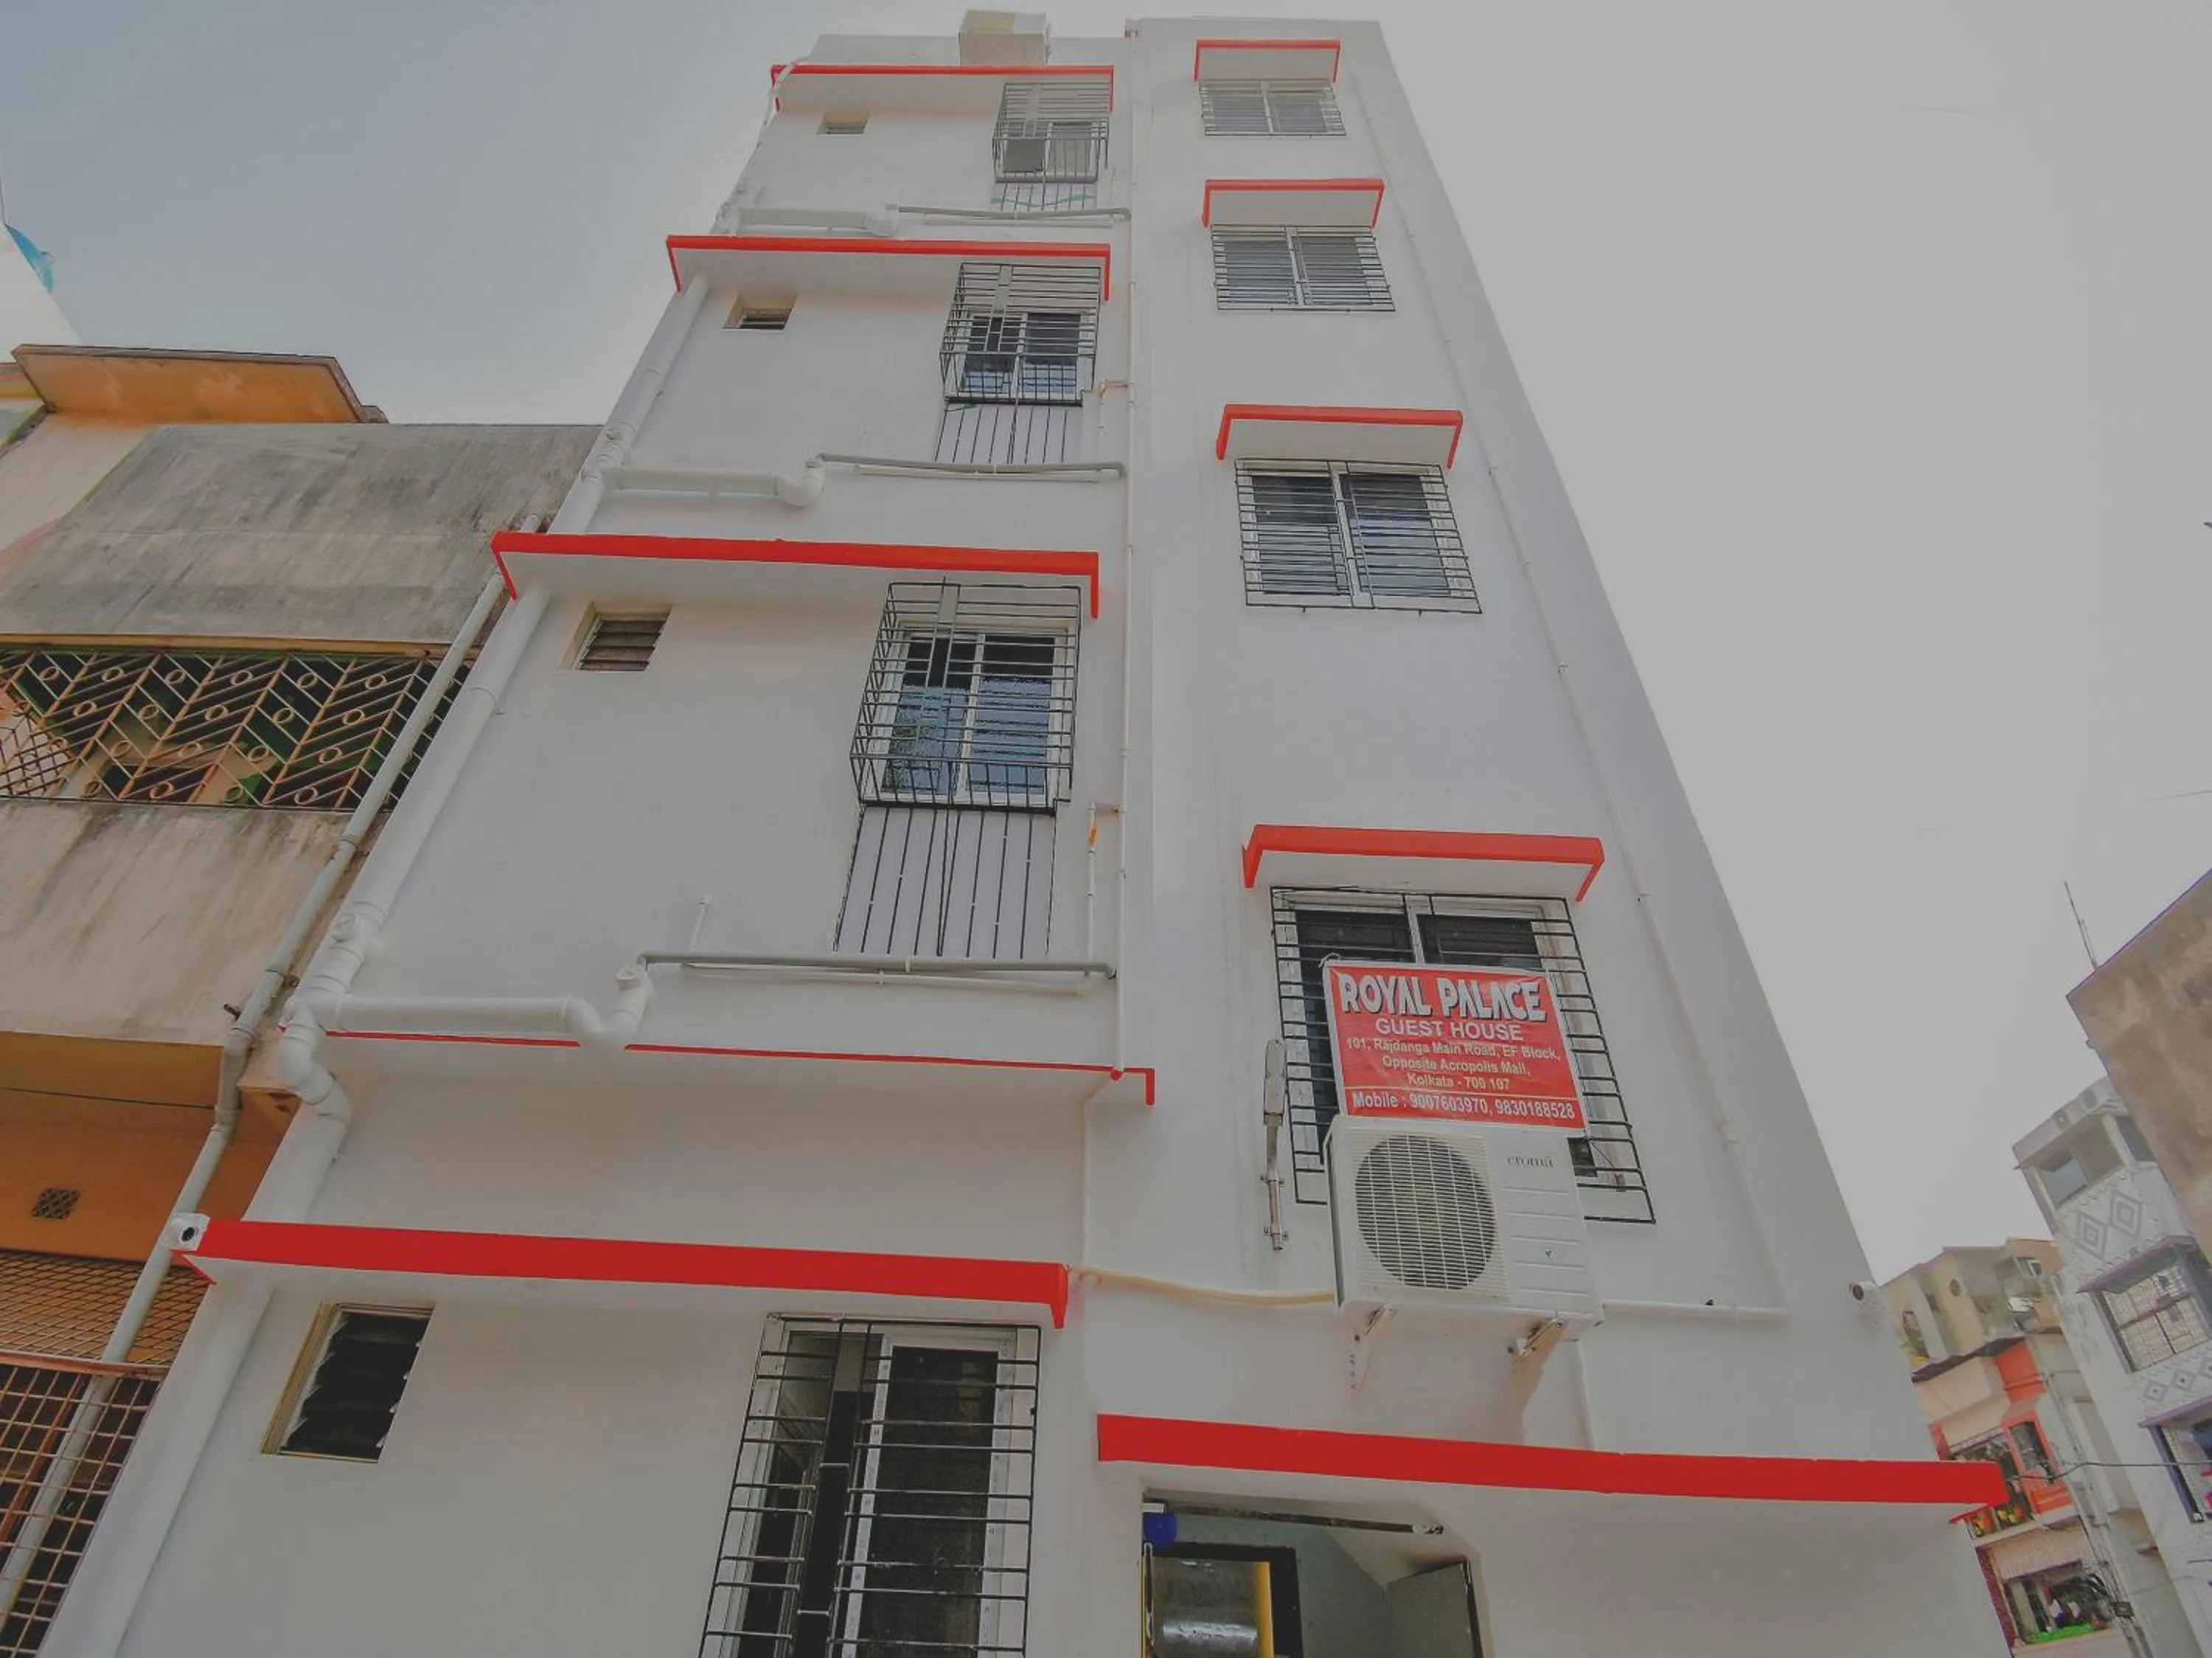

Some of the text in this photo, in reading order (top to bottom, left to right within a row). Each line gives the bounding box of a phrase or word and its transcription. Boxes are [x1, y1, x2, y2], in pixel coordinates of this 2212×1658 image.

[1338, 973, 1547, 1022] ROYAL PALACE
[1375, 1017, 1524, 1041] GUEST HOUSE
[1346, 1038, 1371, 1051] 101,
[1374, 1038, 1430, 1055] Rajdanga
[1433, 1041, 1461, 1055] Main
[1464, 1042, 1500, 1058] Road,
[1521, 1046, 1561, 1061] Block,
[1382, 1055, 1437, 1071] Opposite
[1440, 1057, 1498, 1075] Acropolis
[1407, 1072, 1454, 1087] Kolkata
[1463, 1076, 1486, 1090] 700
[1489, 1078, 1511, 1090] 107
[1352, 1091, 1399, 1109] Mobile
[1495, 1099, 1576, 1120] 9830188528
